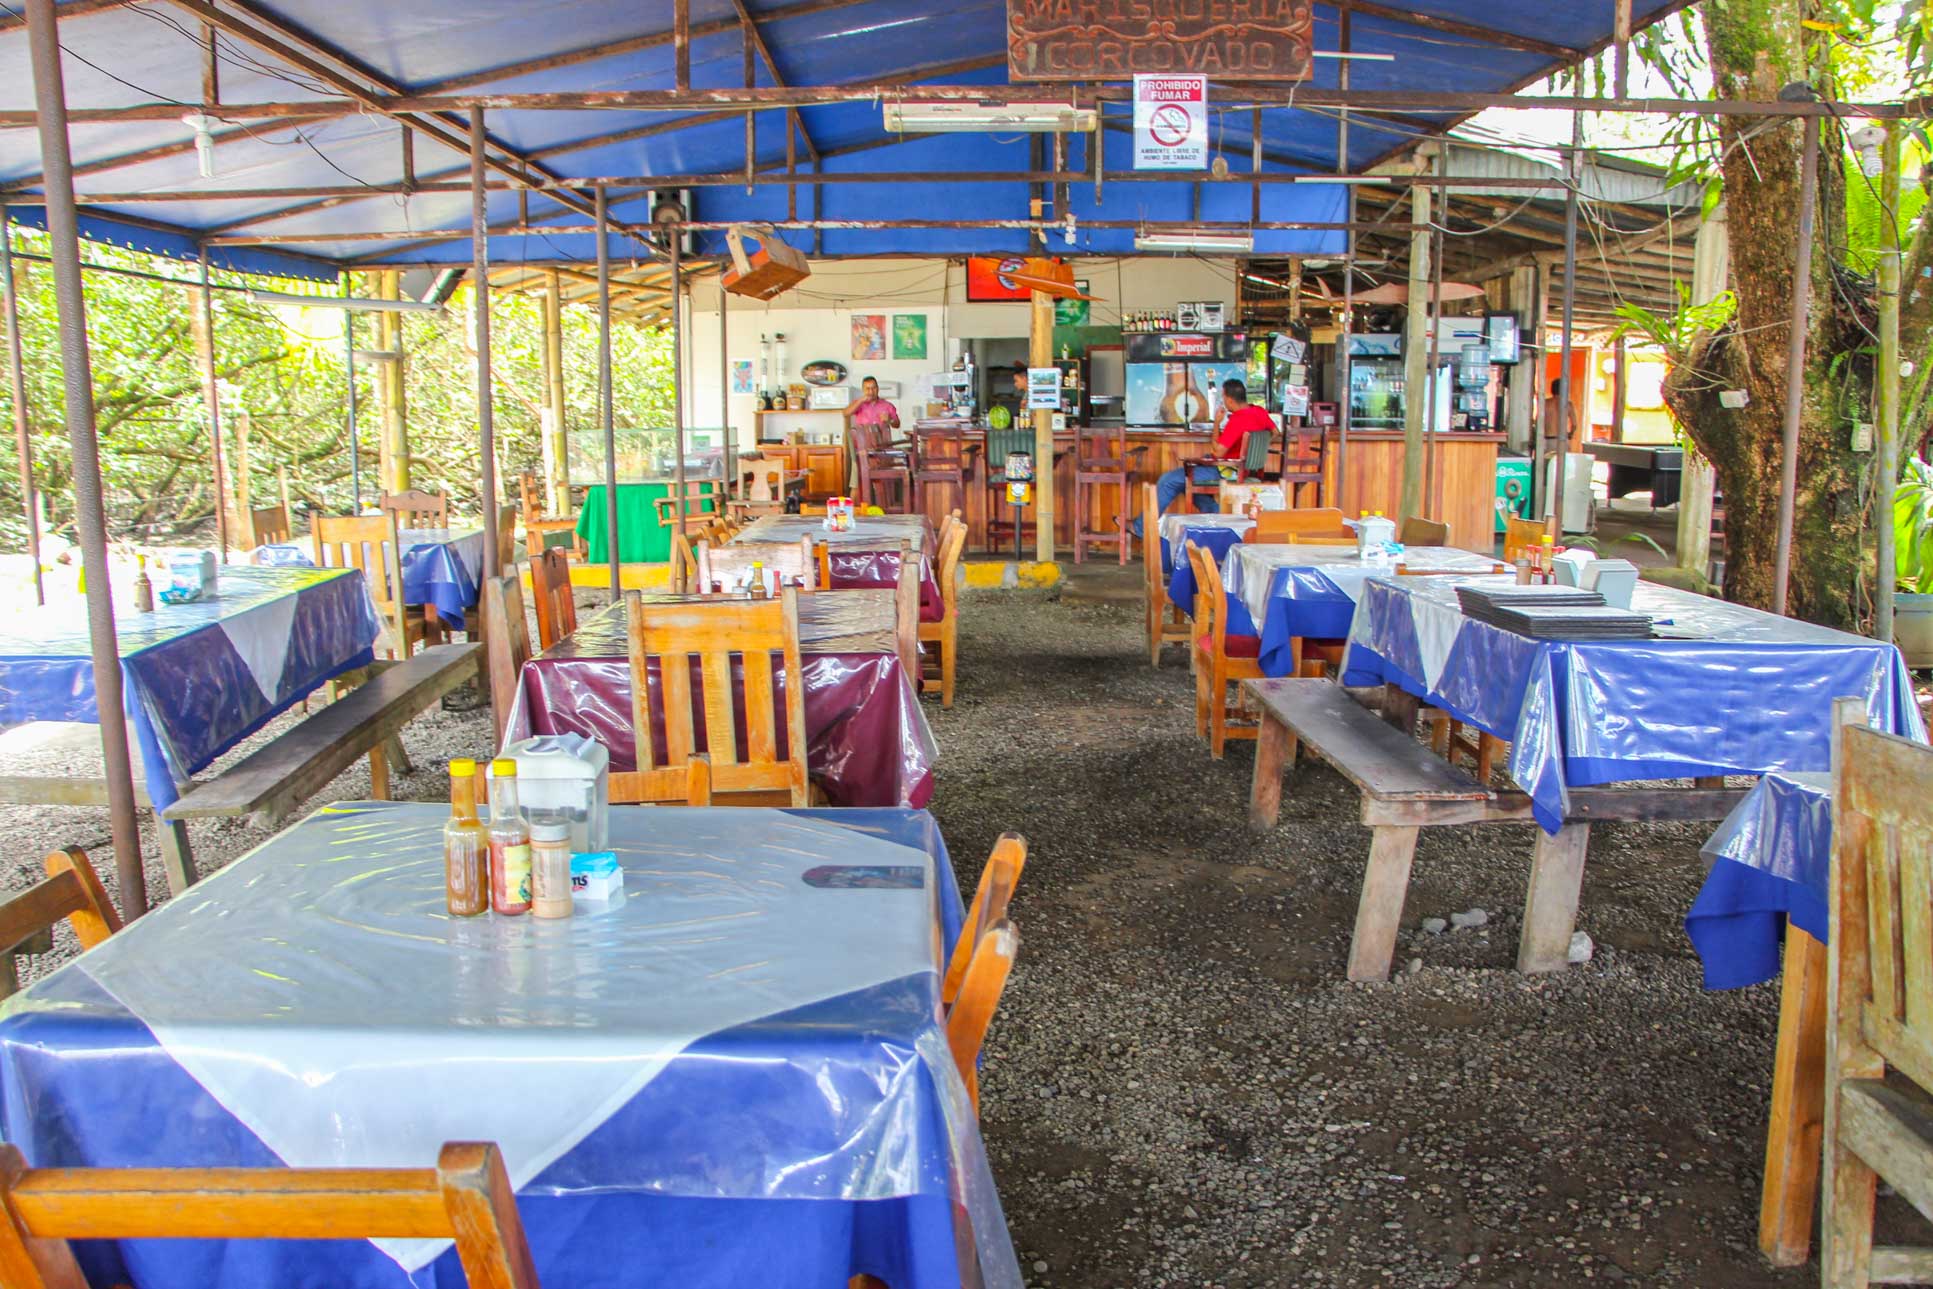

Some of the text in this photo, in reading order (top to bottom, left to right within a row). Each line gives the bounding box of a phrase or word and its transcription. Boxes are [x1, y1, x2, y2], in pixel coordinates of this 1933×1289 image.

[1048, 41, 1274, 70] CORCOVADO
[1140, 81, 1200, 90] PROHIBIDO
[1151, 91, 1190, 100] FUMAR
[1176, 340, 1210, 355] Imperial
